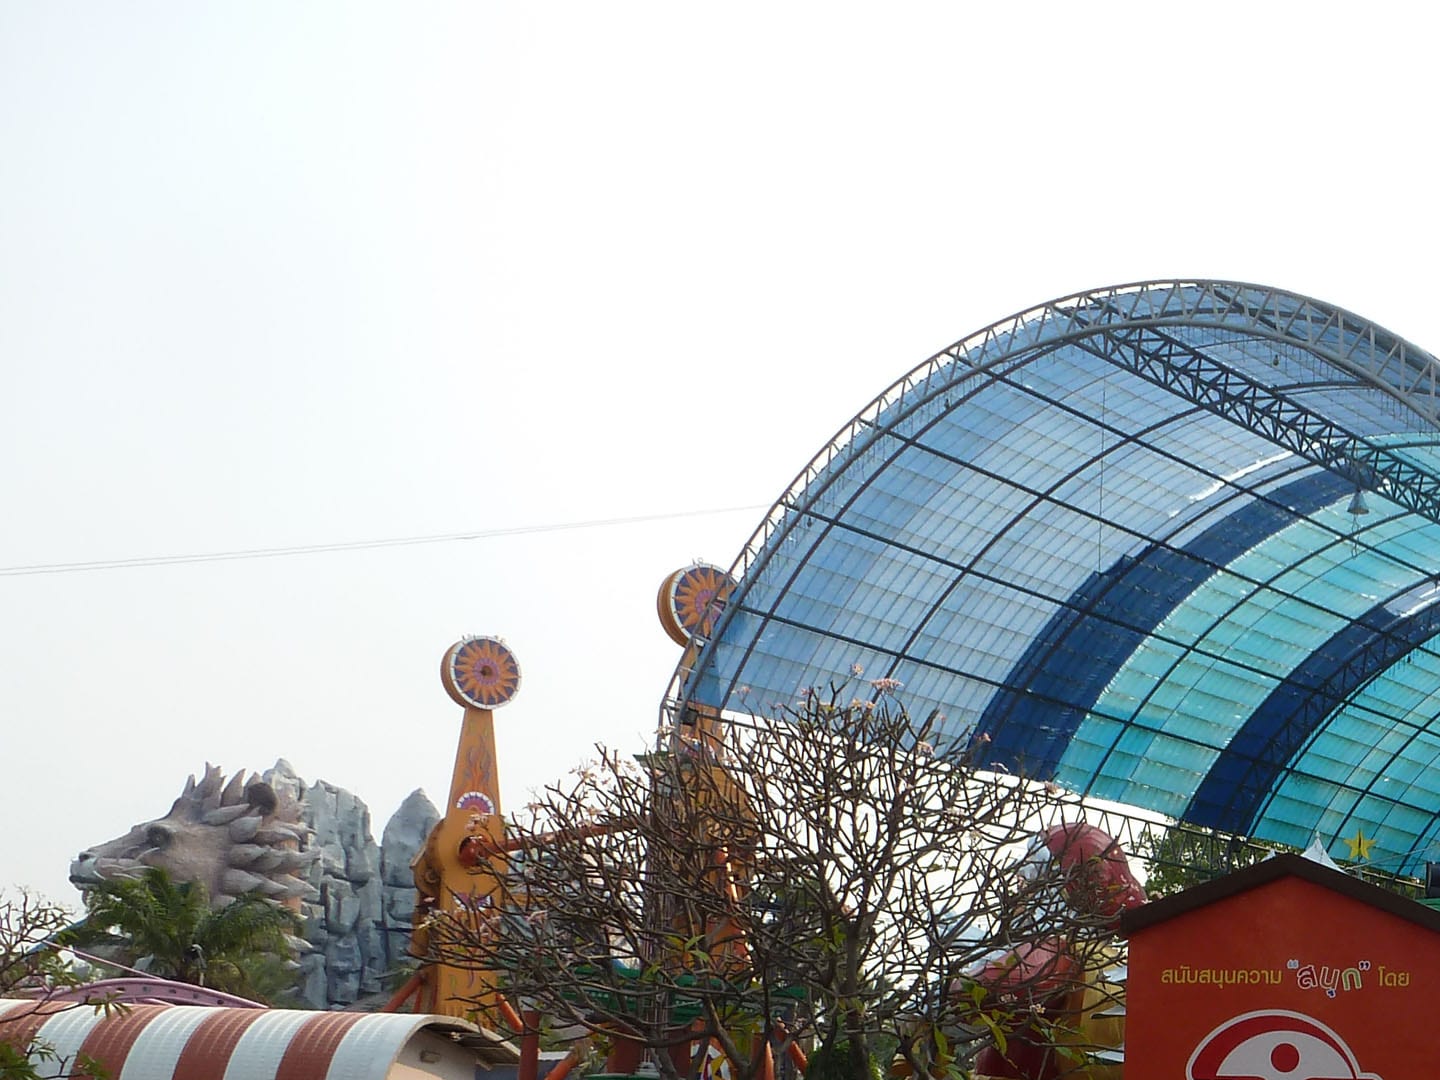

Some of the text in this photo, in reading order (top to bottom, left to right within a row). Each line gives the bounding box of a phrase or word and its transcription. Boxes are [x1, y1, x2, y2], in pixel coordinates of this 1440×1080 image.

[1160, 964, 1283, 989] สนับสนุนความ
[1377, 966, 1410, 988] โดย
